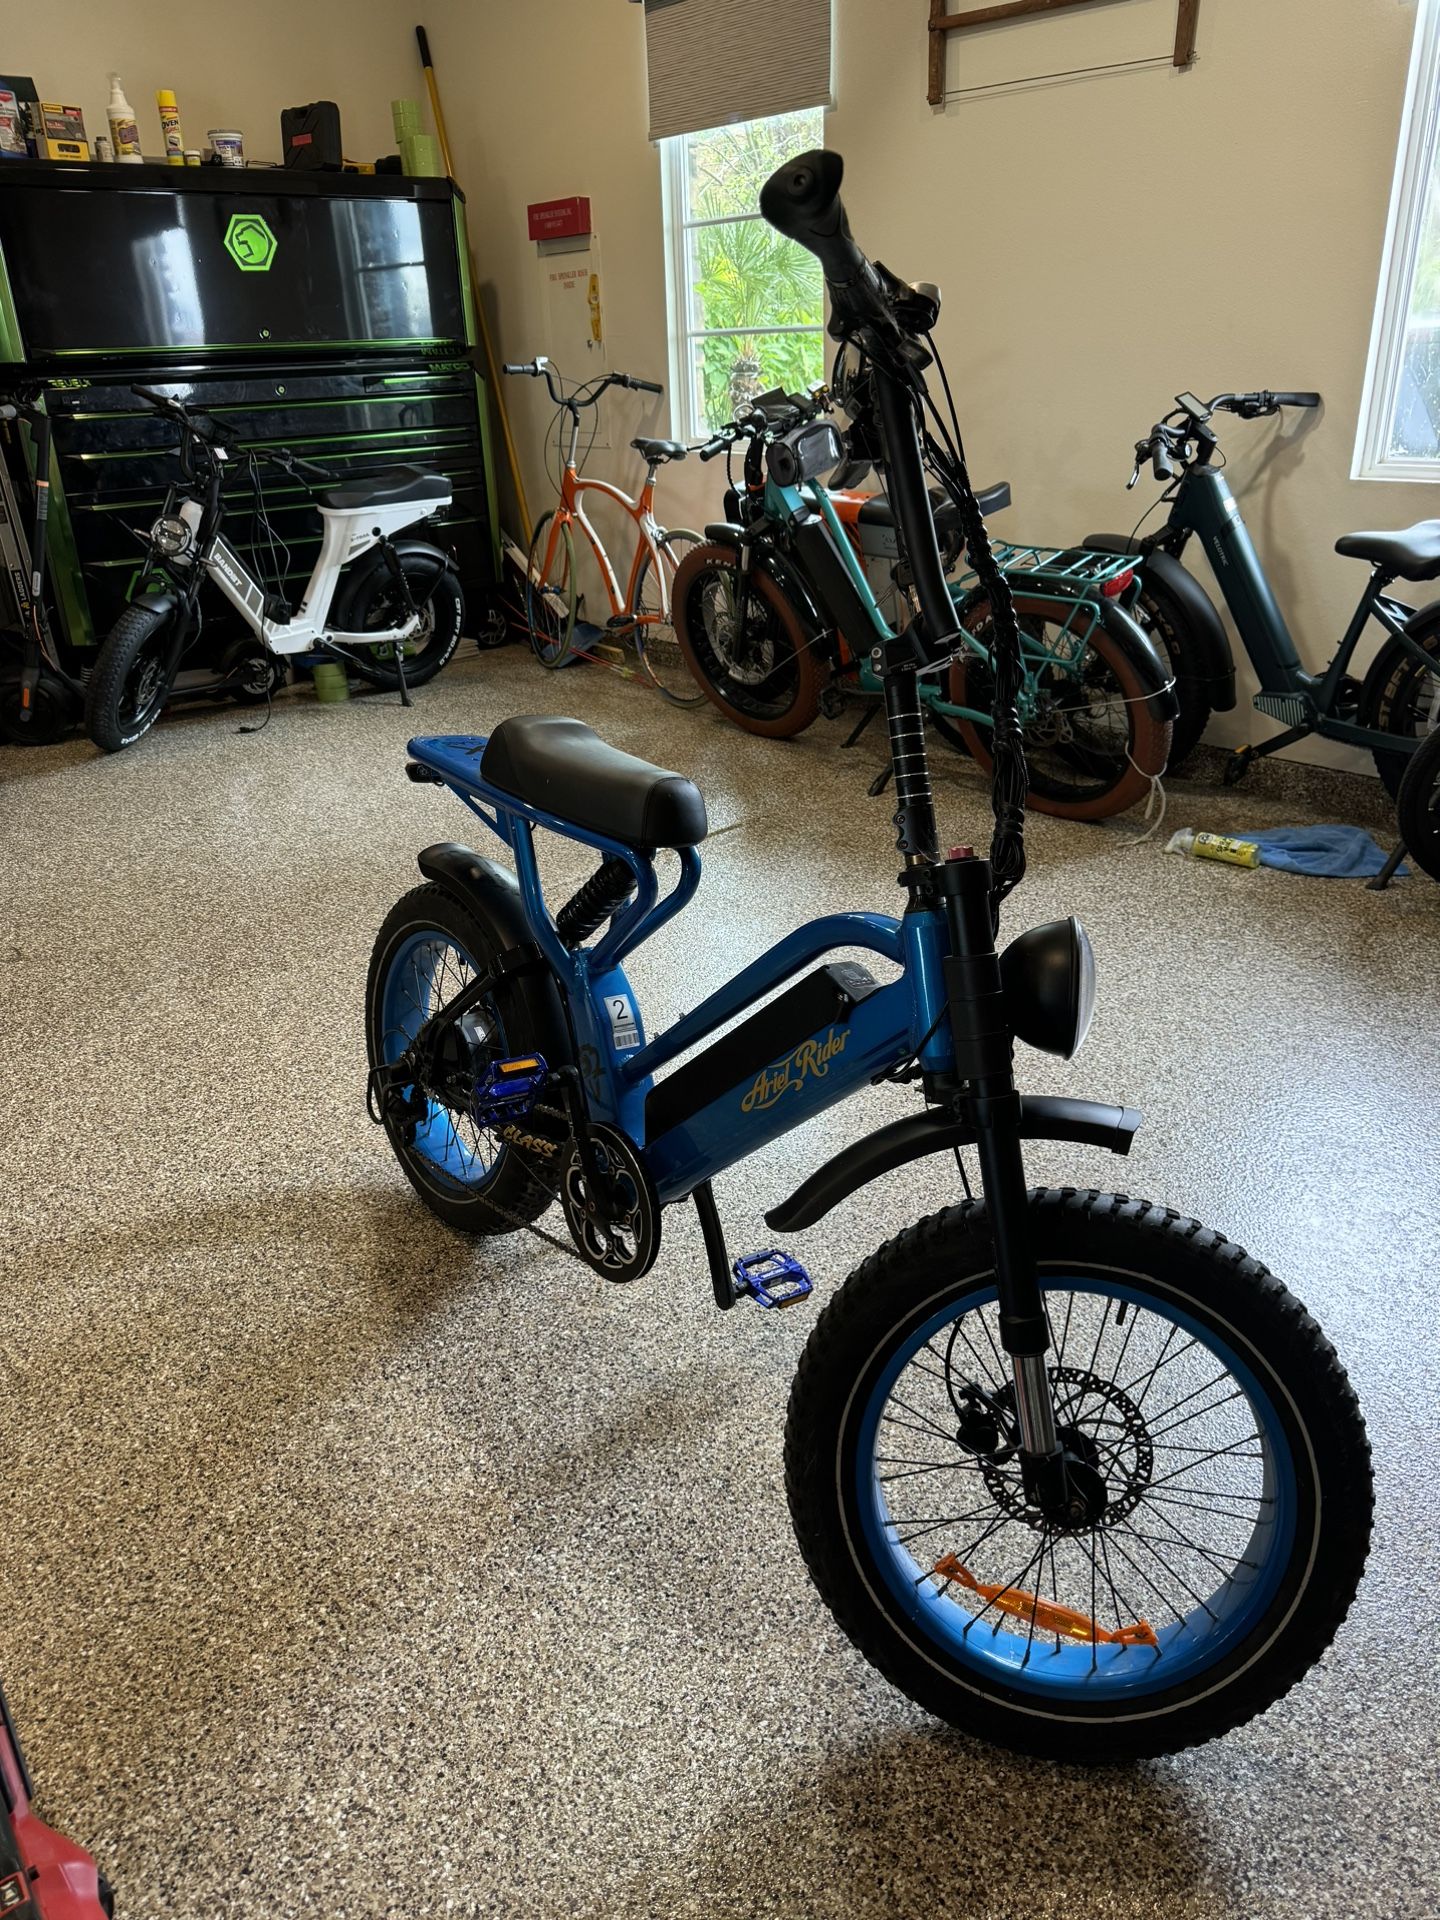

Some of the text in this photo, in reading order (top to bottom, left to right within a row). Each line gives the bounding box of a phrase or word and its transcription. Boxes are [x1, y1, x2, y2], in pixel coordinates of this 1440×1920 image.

[161, 119, 180, 130] OVEN
[14, 571, 28, 601] LADDERS
[1378, 700, 1392, 732] ST
[612, 999, 629, 1020] 2
[741, 1028, 851, 1112] Ariel Rider
